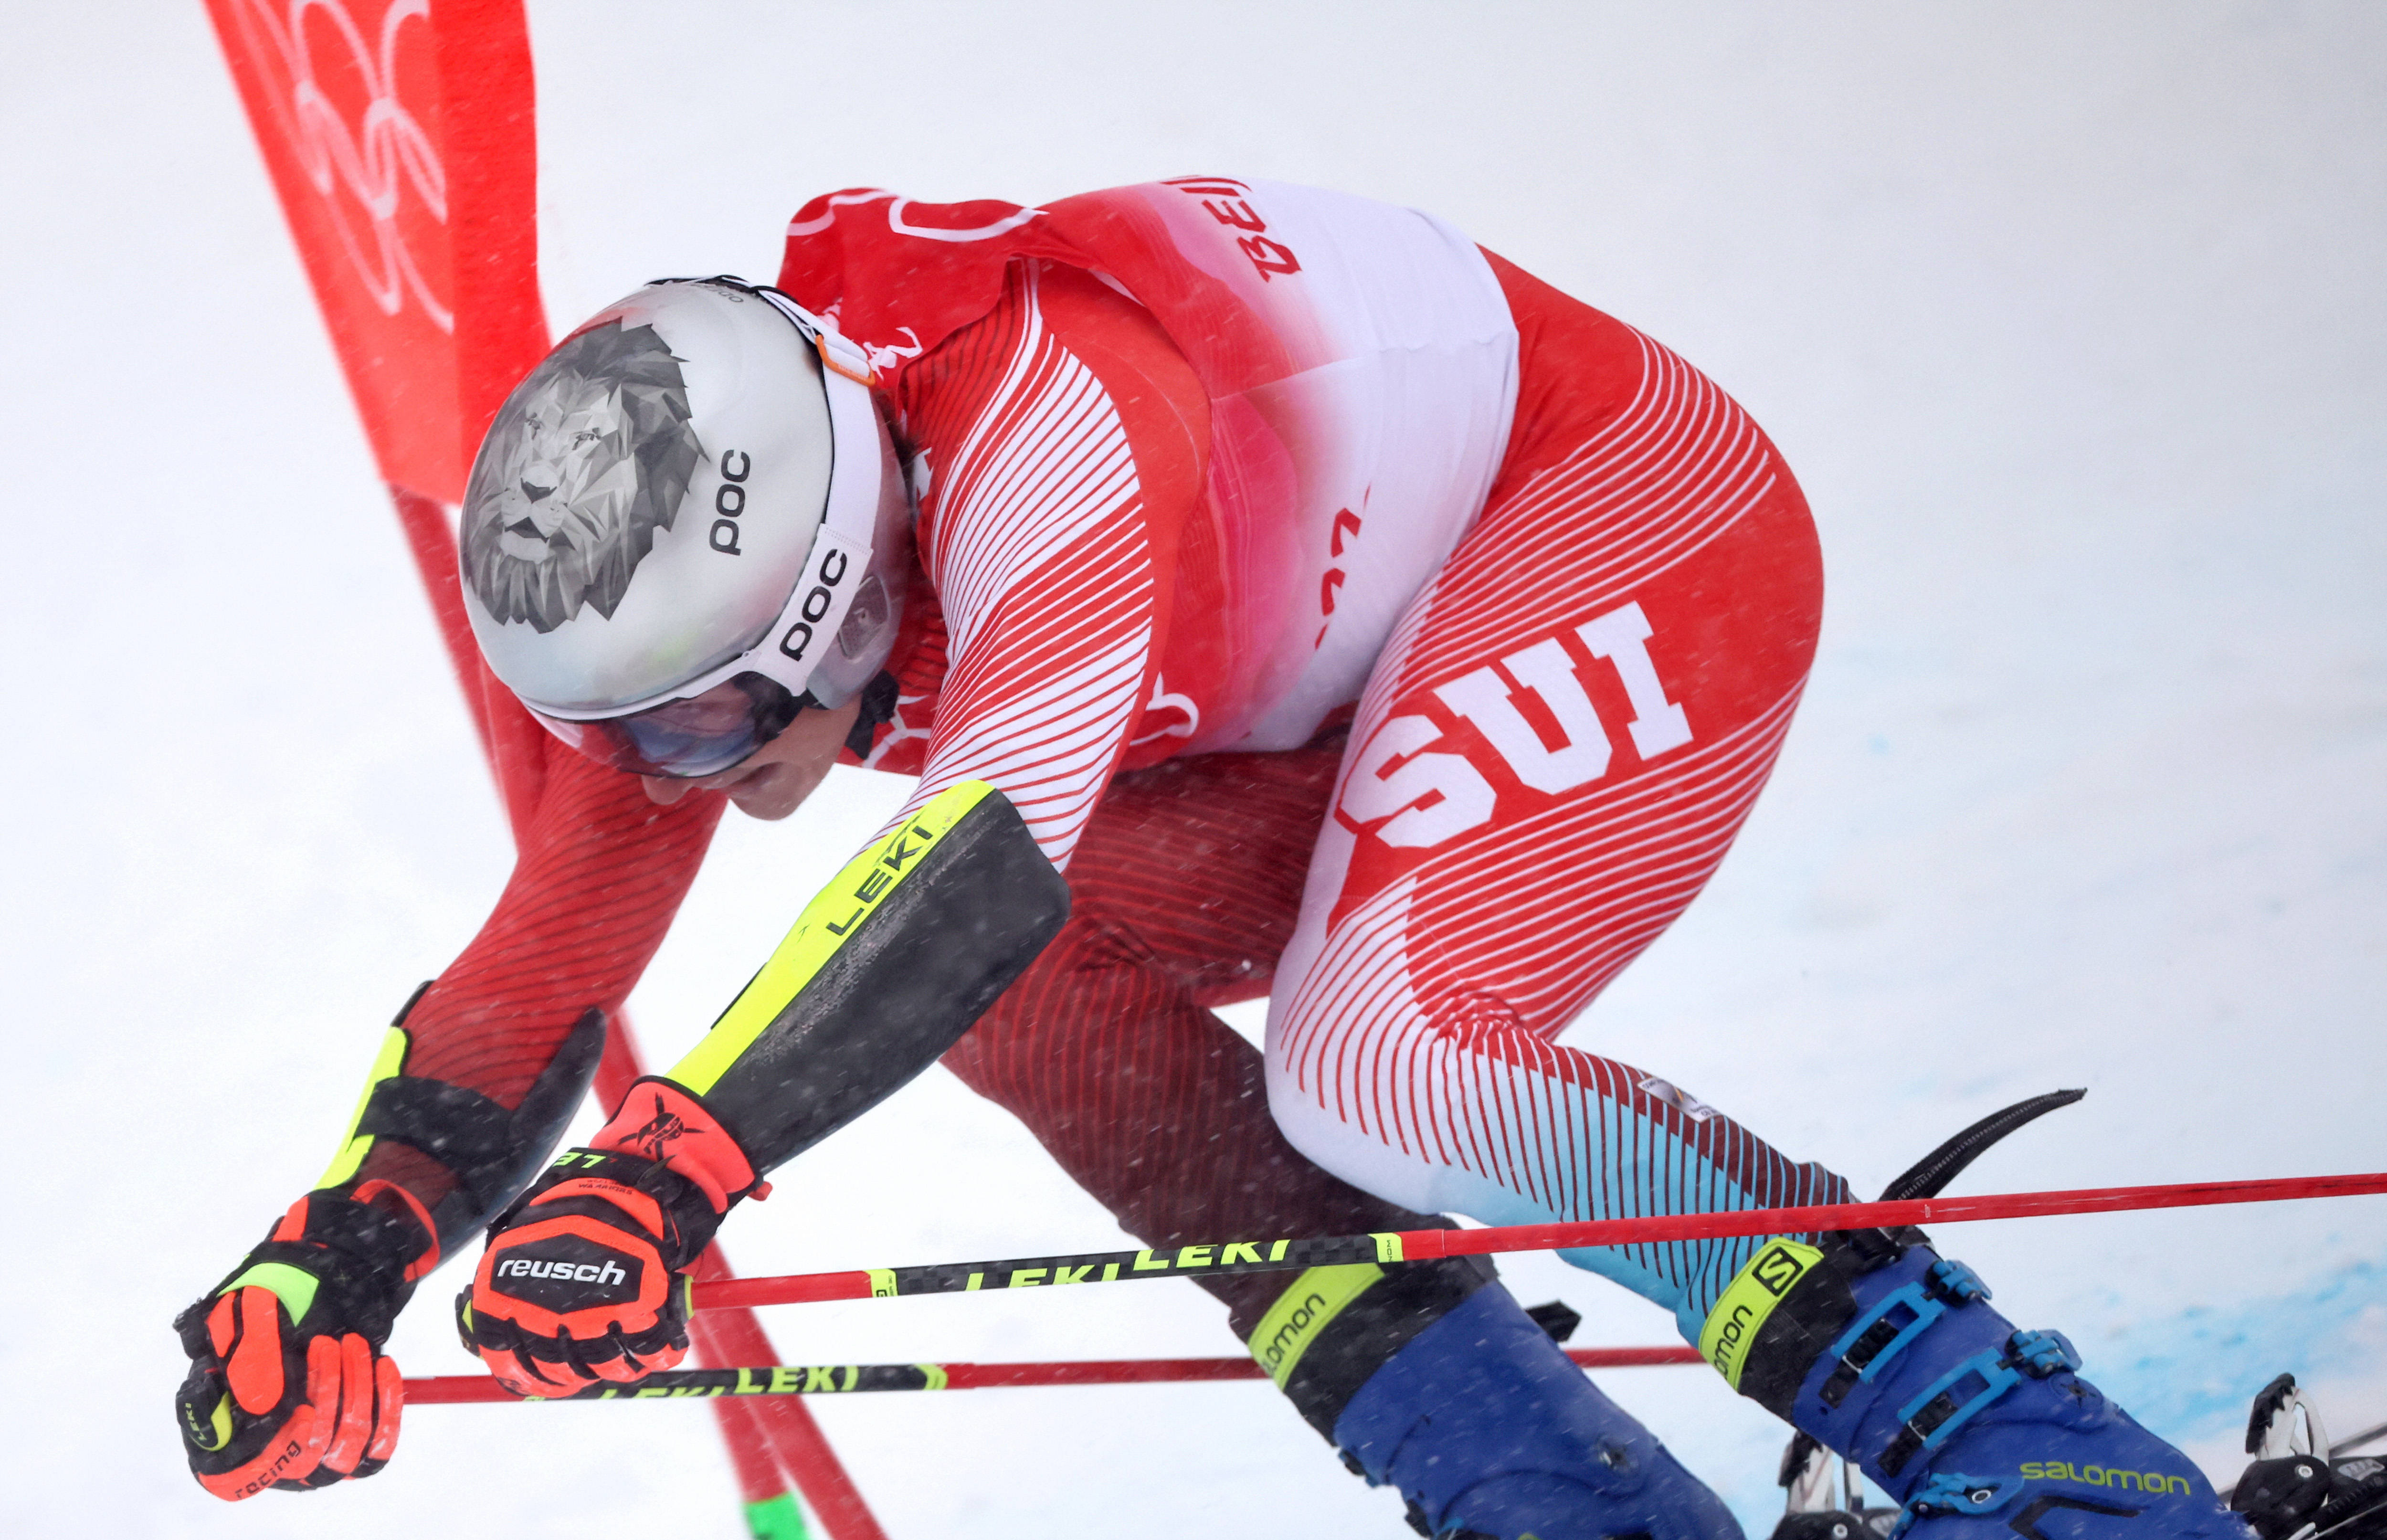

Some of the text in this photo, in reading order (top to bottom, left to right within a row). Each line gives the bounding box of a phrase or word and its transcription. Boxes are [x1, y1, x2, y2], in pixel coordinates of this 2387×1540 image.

[1340, 600, 1694, 848] SUI
[825, 825, 933, 936] LEKI
[497, 1259, 626, 1286] reusch
[1132, 1239, 1291, 1271] LEKI
[1264, 1293, 1326, 1371] omon
[733, 1366, 859, 1394] LEKI
[234, 1440, 302, 1499] racing
[2019, 1461, 2191, 1495] salomon
